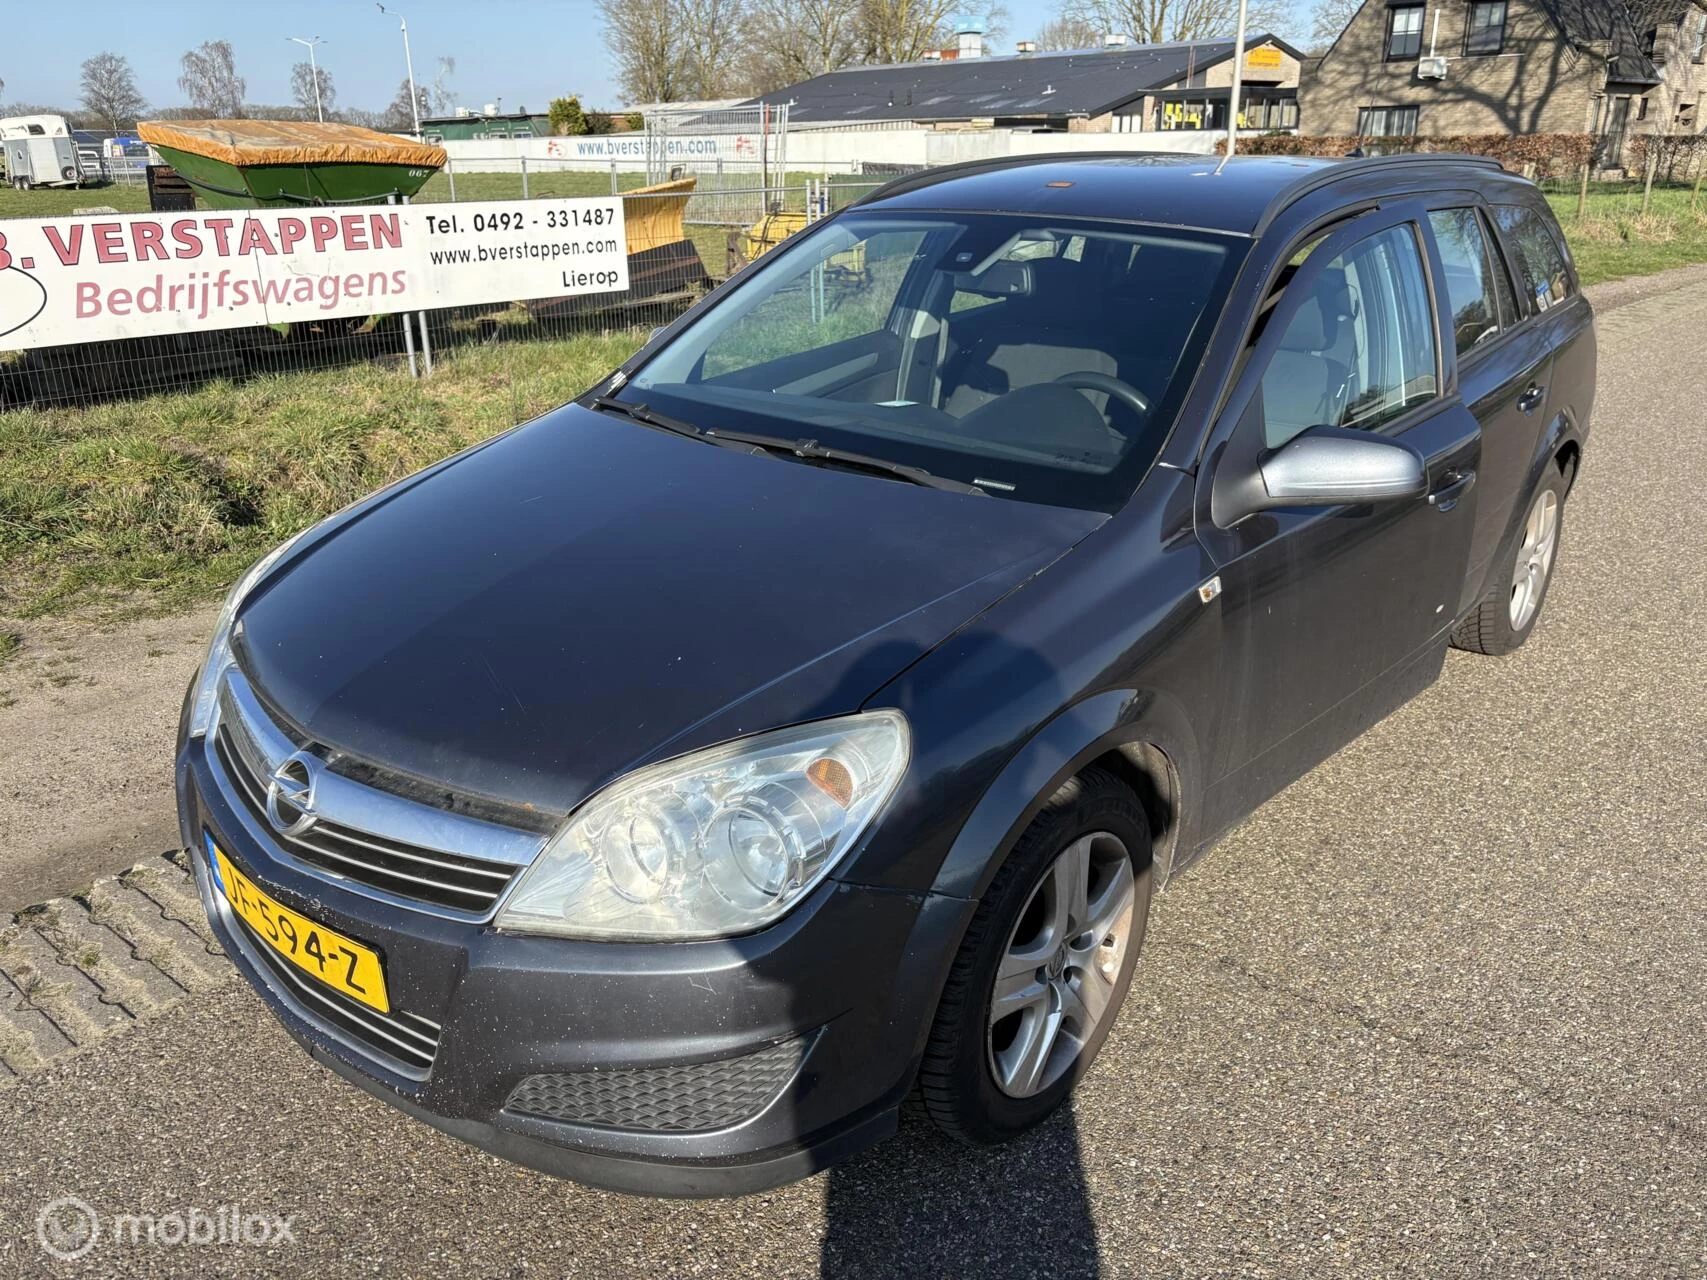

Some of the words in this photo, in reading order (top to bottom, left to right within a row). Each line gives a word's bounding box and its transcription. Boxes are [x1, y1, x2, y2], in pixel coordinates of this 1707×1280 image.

[41, 213, 403, 266] VERSTAPPEN
[426, 215, 465, 234] Tel.
[473, 212, 524, 232] 0492
[547, 208, 615, 228] 331487
[430, 239, 618, 265] www.bverstappen.com
[76, 269, 406, 320] Bedrijfswagens
[562, 270, 619, 287] Lierop
[227, 867, 366, 995] JF-594-Z
